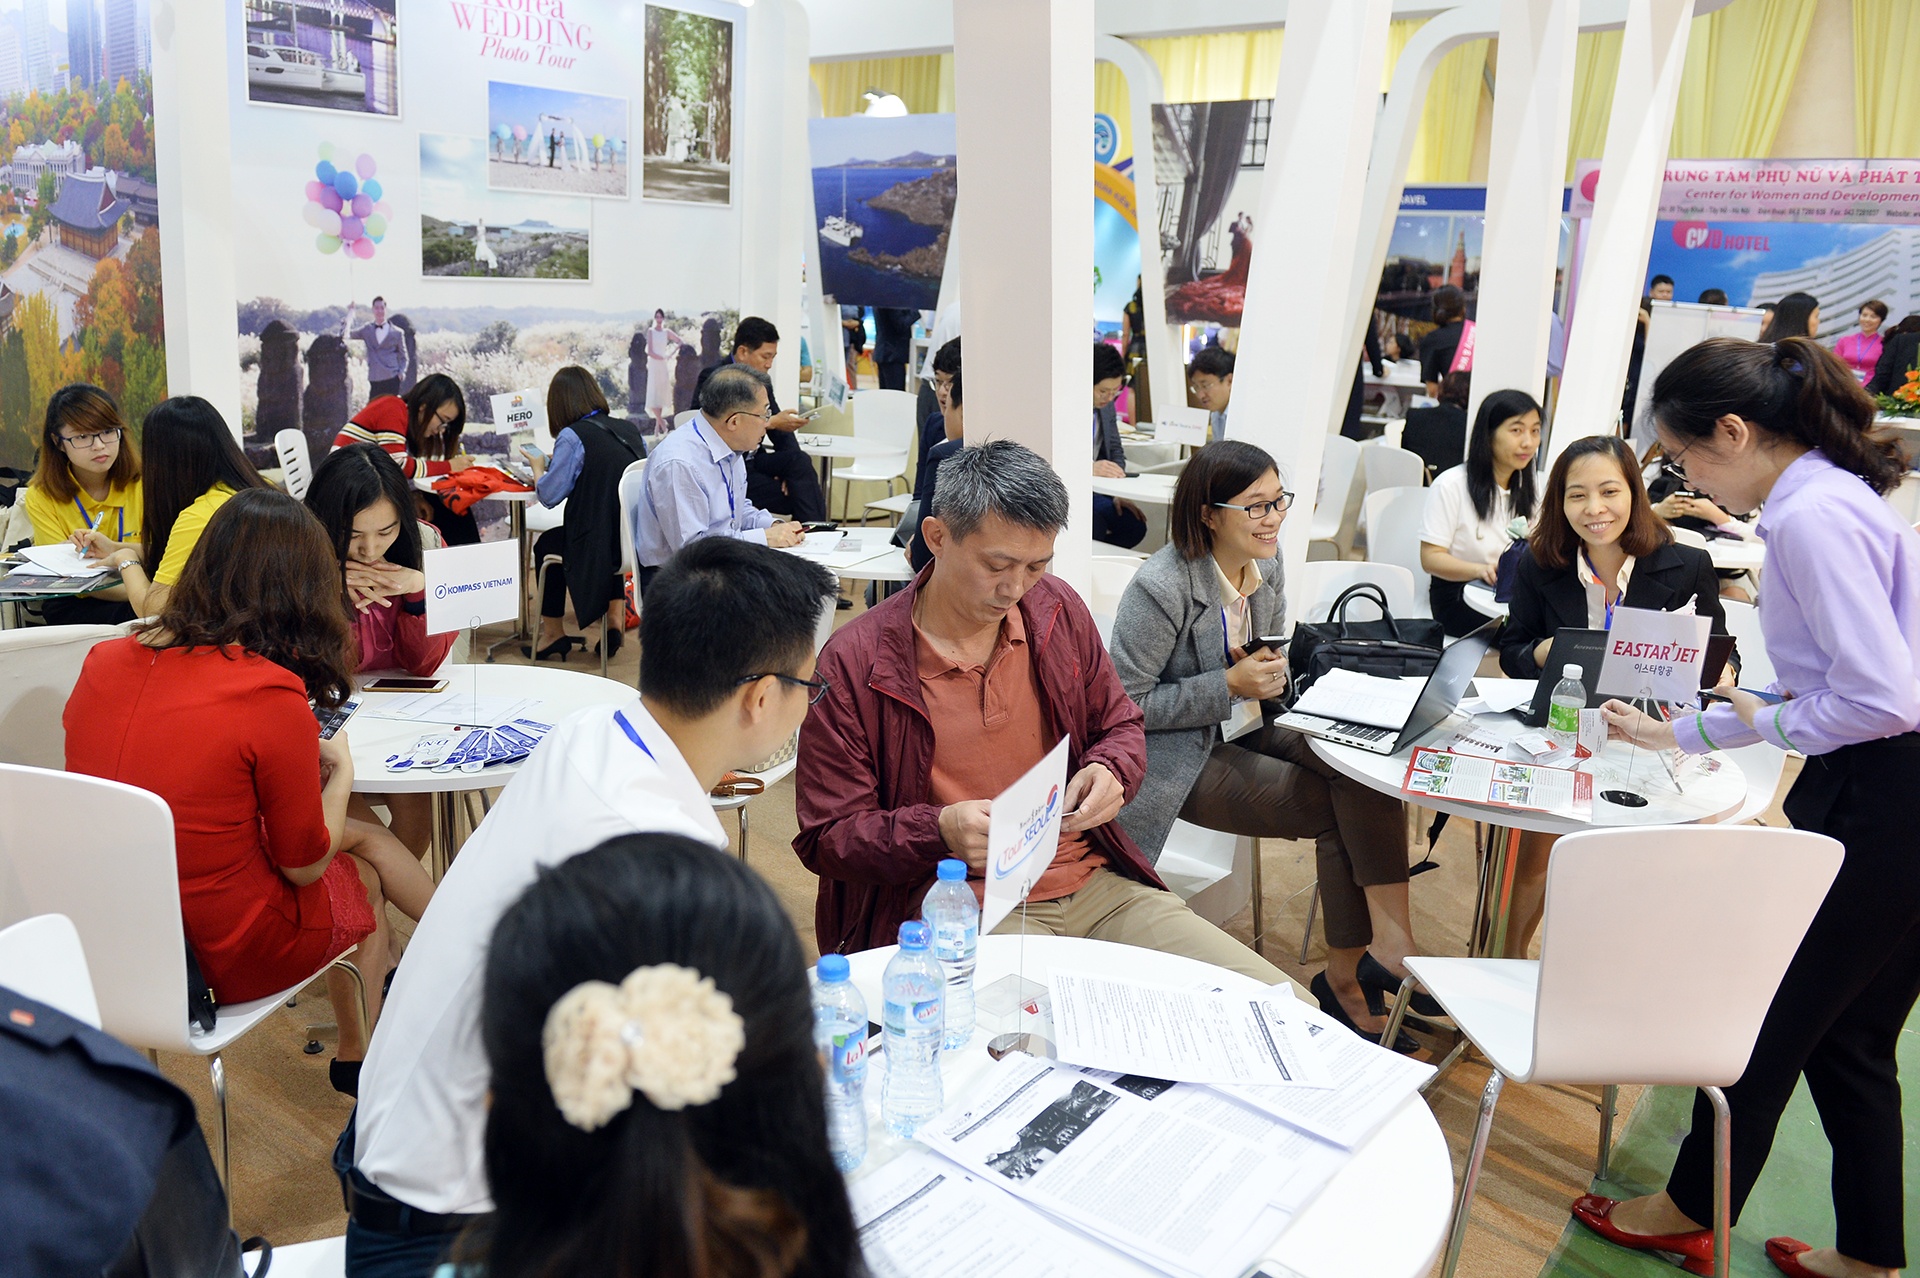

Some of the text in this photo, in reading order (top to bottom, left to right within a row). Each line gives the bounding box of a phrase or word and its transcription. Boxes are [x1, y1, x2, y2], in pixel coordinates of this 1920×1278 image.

[452, 2, 593, 51] WEDDING
[479, 36, 577, 70] Photo Tour
[1663, 170, 1710, 183] RUNG
[1756, 170, 1790, 186] PHỤ
[1859, 167, 1908, 184] PHÁT
[1685, 188, 1920, 203] Center for Women and Developmen
[1724, 235, 1771, 251] HOTEL
[506, 410, 533, 423] HERO
[447, 577, 513, 595] KOMPASS VIETNAM
[1612, 640, 1700, 663] EASTAR JET
[1634, 663, 1673, 677] 이스타항공
